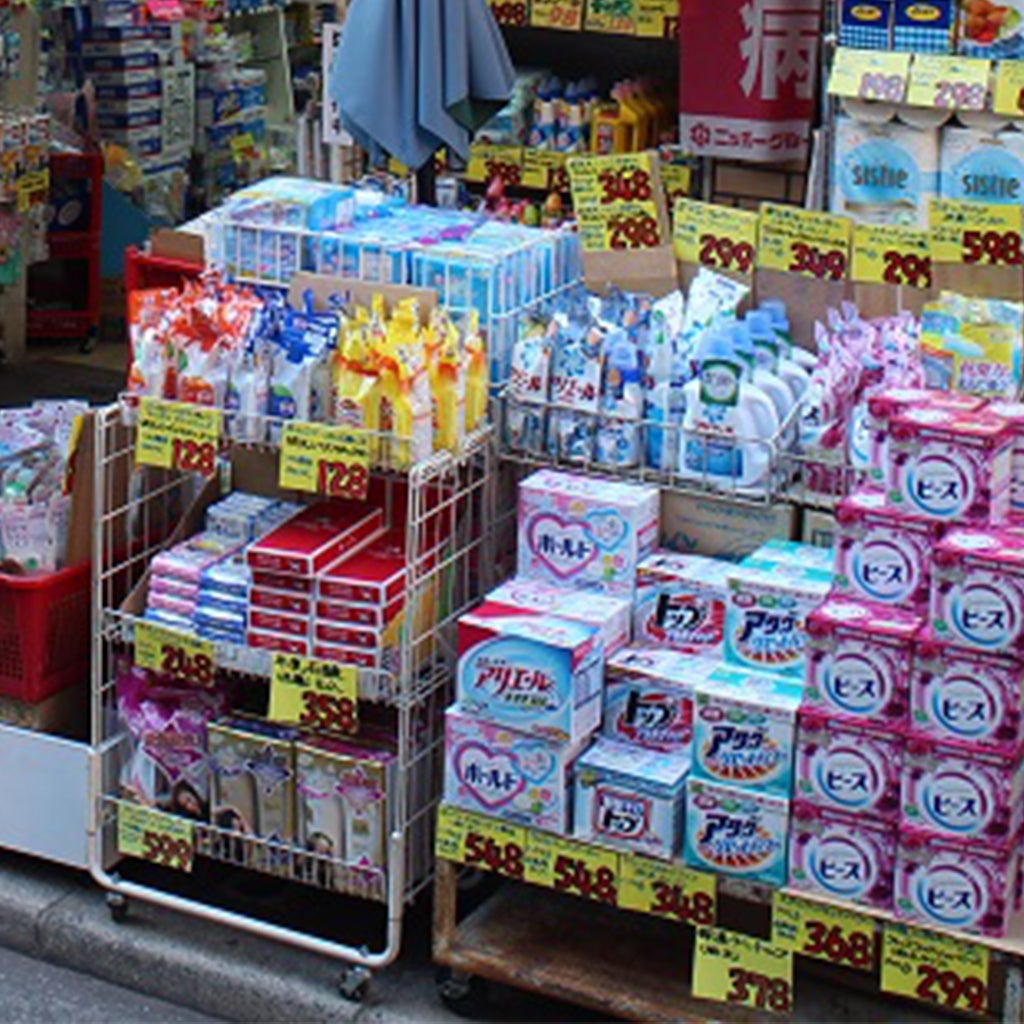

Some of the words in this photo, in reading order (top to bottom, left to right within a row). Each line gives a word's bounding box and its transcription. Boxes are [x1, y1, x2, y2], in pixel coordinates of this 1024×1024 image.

[699, 233, 755, 272] 299
[962, 230, 1022, 265] 598
[320, 459, 368, 500] 128
[474, 666, 555, 695] アリエール
[465, 832, 525, 876] 548
[554, 854, 618, 906] 548
[804, 920, 872, 970] 368
[728, 967, 791, 1012] 378
[916, 964, 987, 1011] 299
